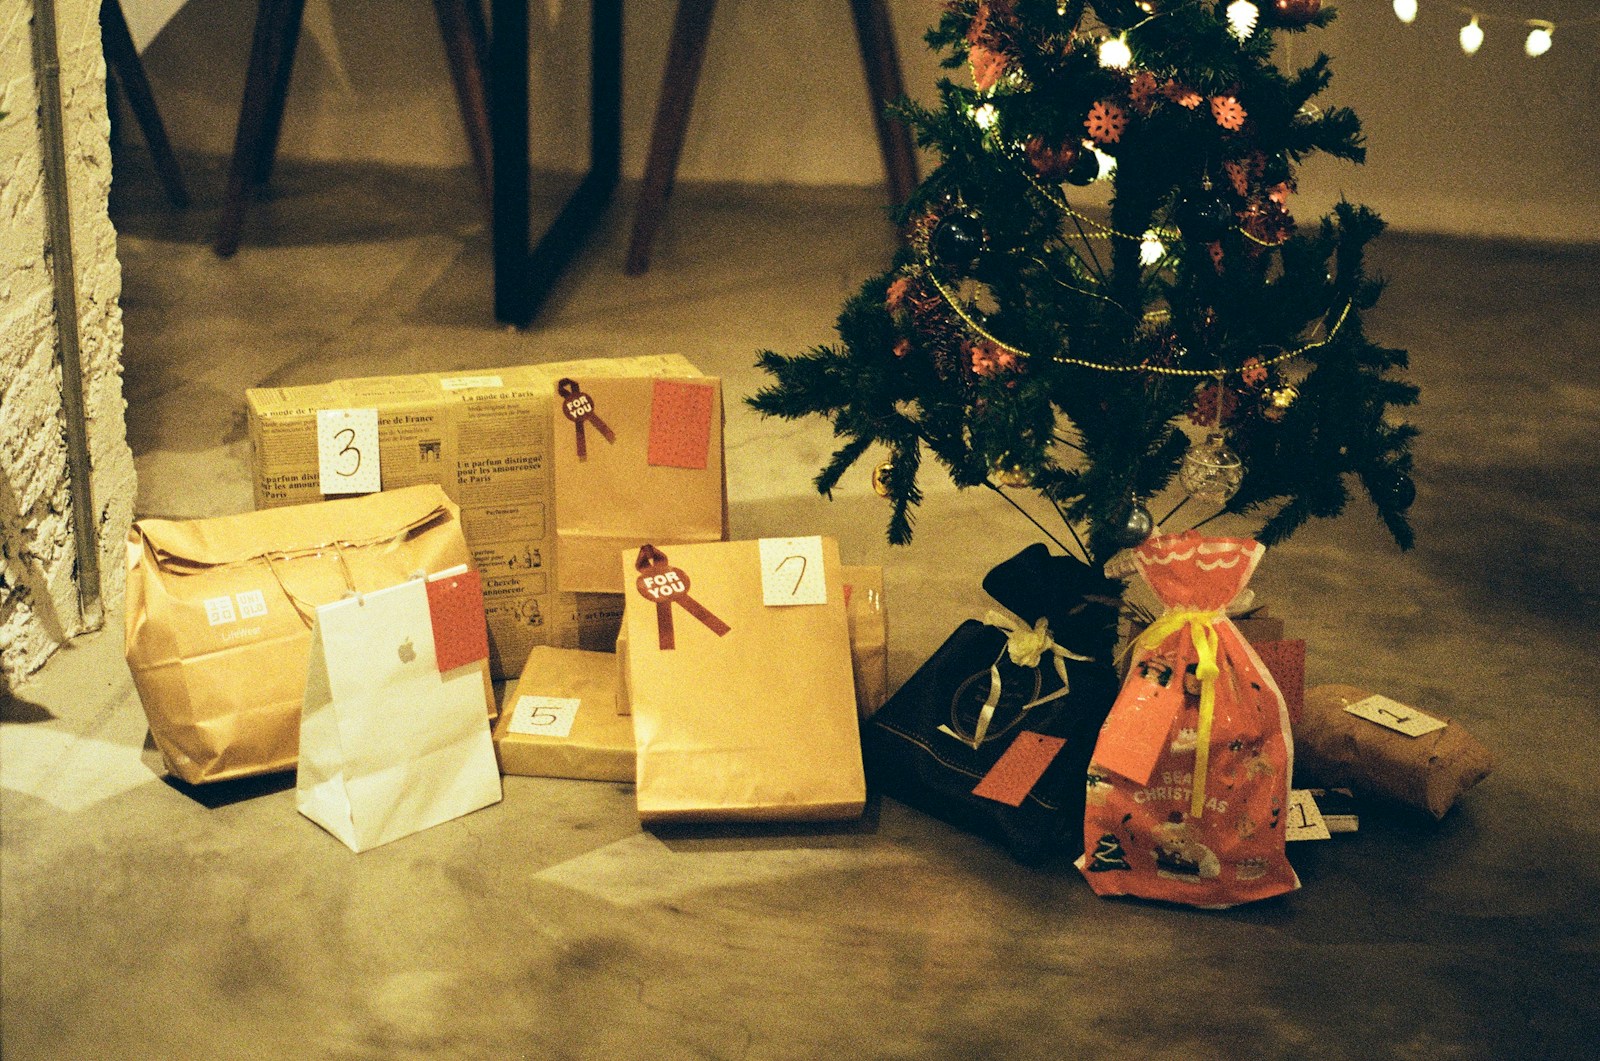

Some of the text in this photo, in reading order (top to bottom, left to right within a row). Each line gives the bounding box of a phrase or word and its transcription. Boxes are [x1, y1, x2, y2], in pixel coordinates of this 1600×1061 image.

[566, 396, 589, 411] FOR
[570, 403, 592, 418] YOU
[405, 414, 434, 423] France
[334, 428, 361, 477] 3
[471, 458, 502, 469] parfum
[457, 468, 477, 478] pour
[479, 466, 491, 475] les
[470, 475, 491, 483] Paris
[643, 571, 680, 589] FOR
[774, 555, 807, 597] 7
[648, 581, 686, 599] YOU
[530, 706, 562, 727] 5
[1133, 785, 1230, 813] CHRISTAS
